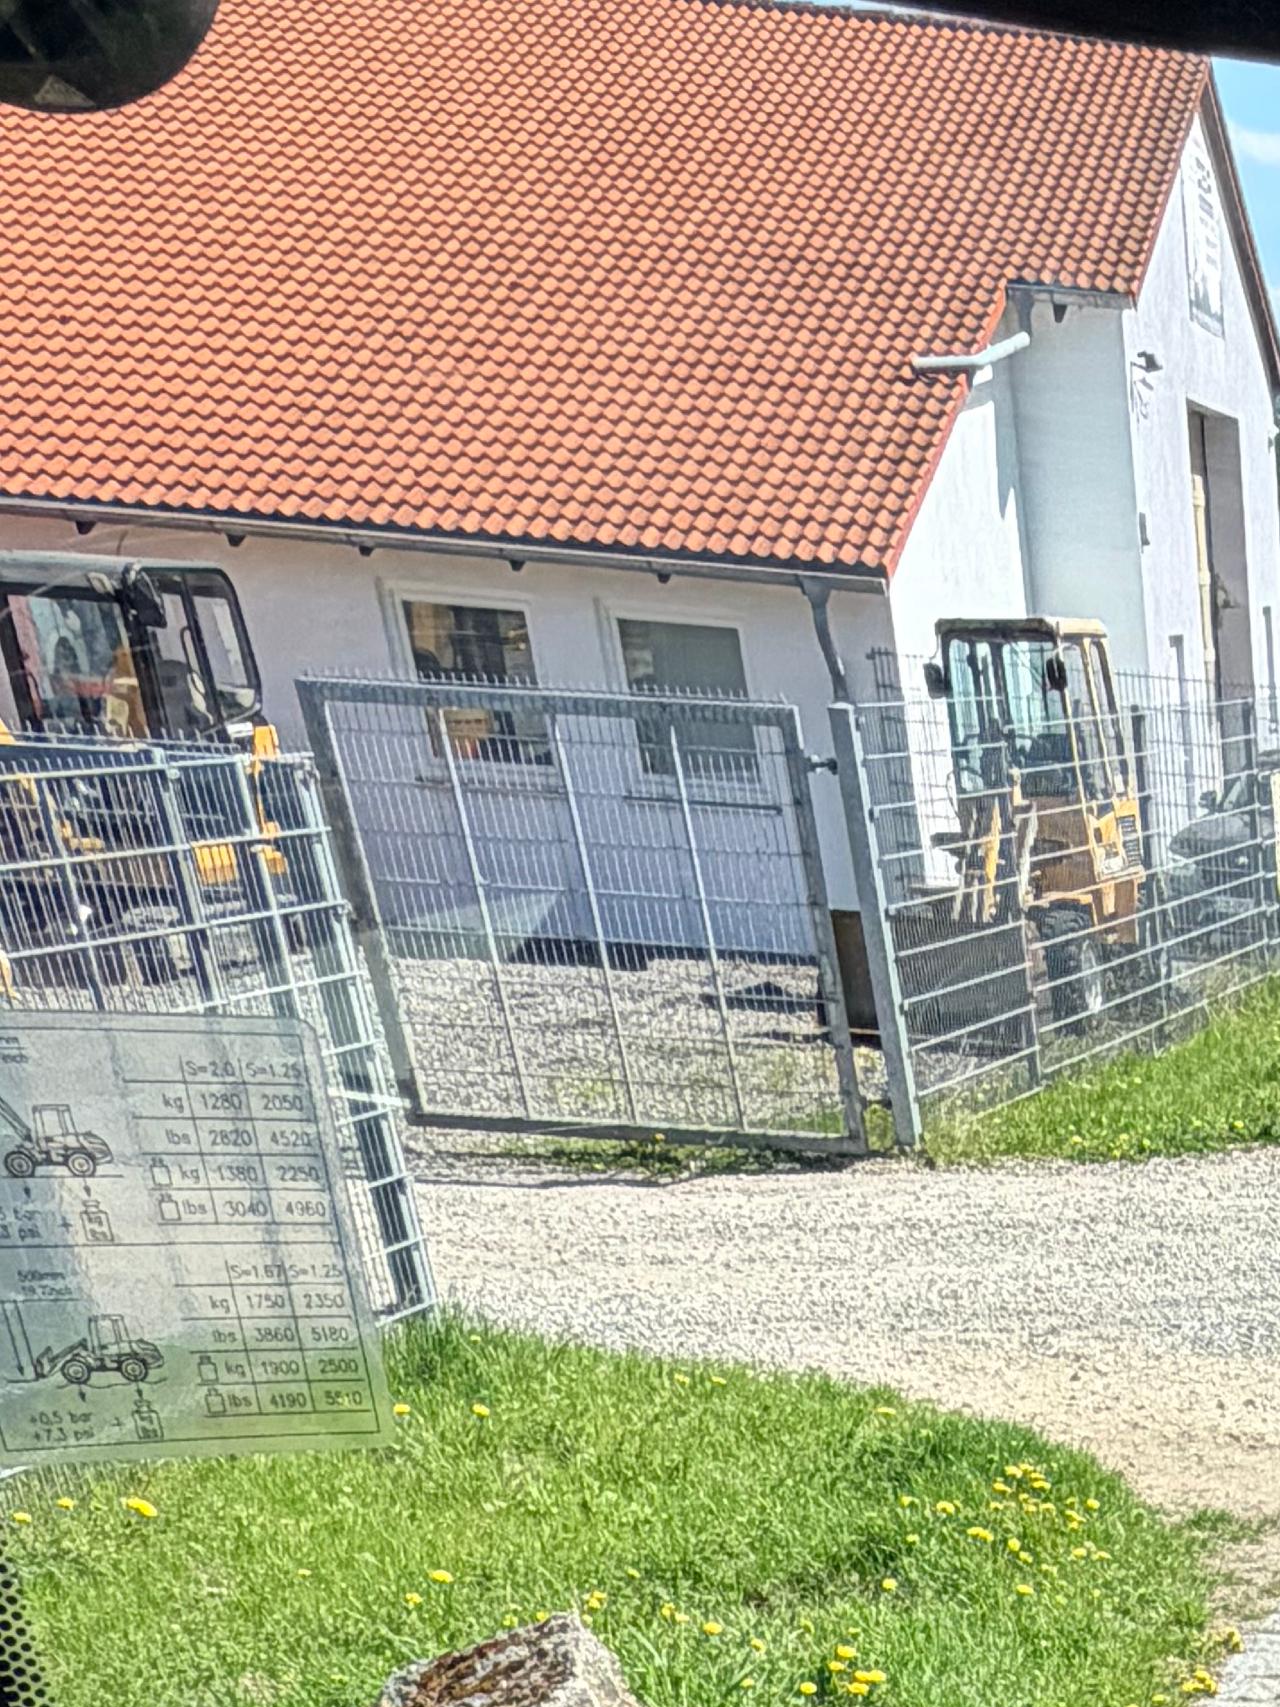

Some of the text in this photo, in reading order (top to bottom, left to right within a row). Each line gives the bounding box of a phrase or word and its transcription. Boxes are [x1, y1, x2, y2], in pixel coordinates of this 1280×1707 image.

[162, 1092, 305, 1114] kg 1280 2050
[165, 1128, 312, 1147] lbs 2820 4520
[178, 1164, 321, 1184] kg 1380 2250
[181, 1200, 327, 1218] lbs 3040 4960
[208, 1292, 346, 1314] kg 1750 2350
[211, 1325, 350, 1344] lbs 3860 5180
[224, 1357, 360, 1378] kg 1900 2500
[227, 1394, 253, 1409] lbs
[269, 1392, 309, 1410] 4190
